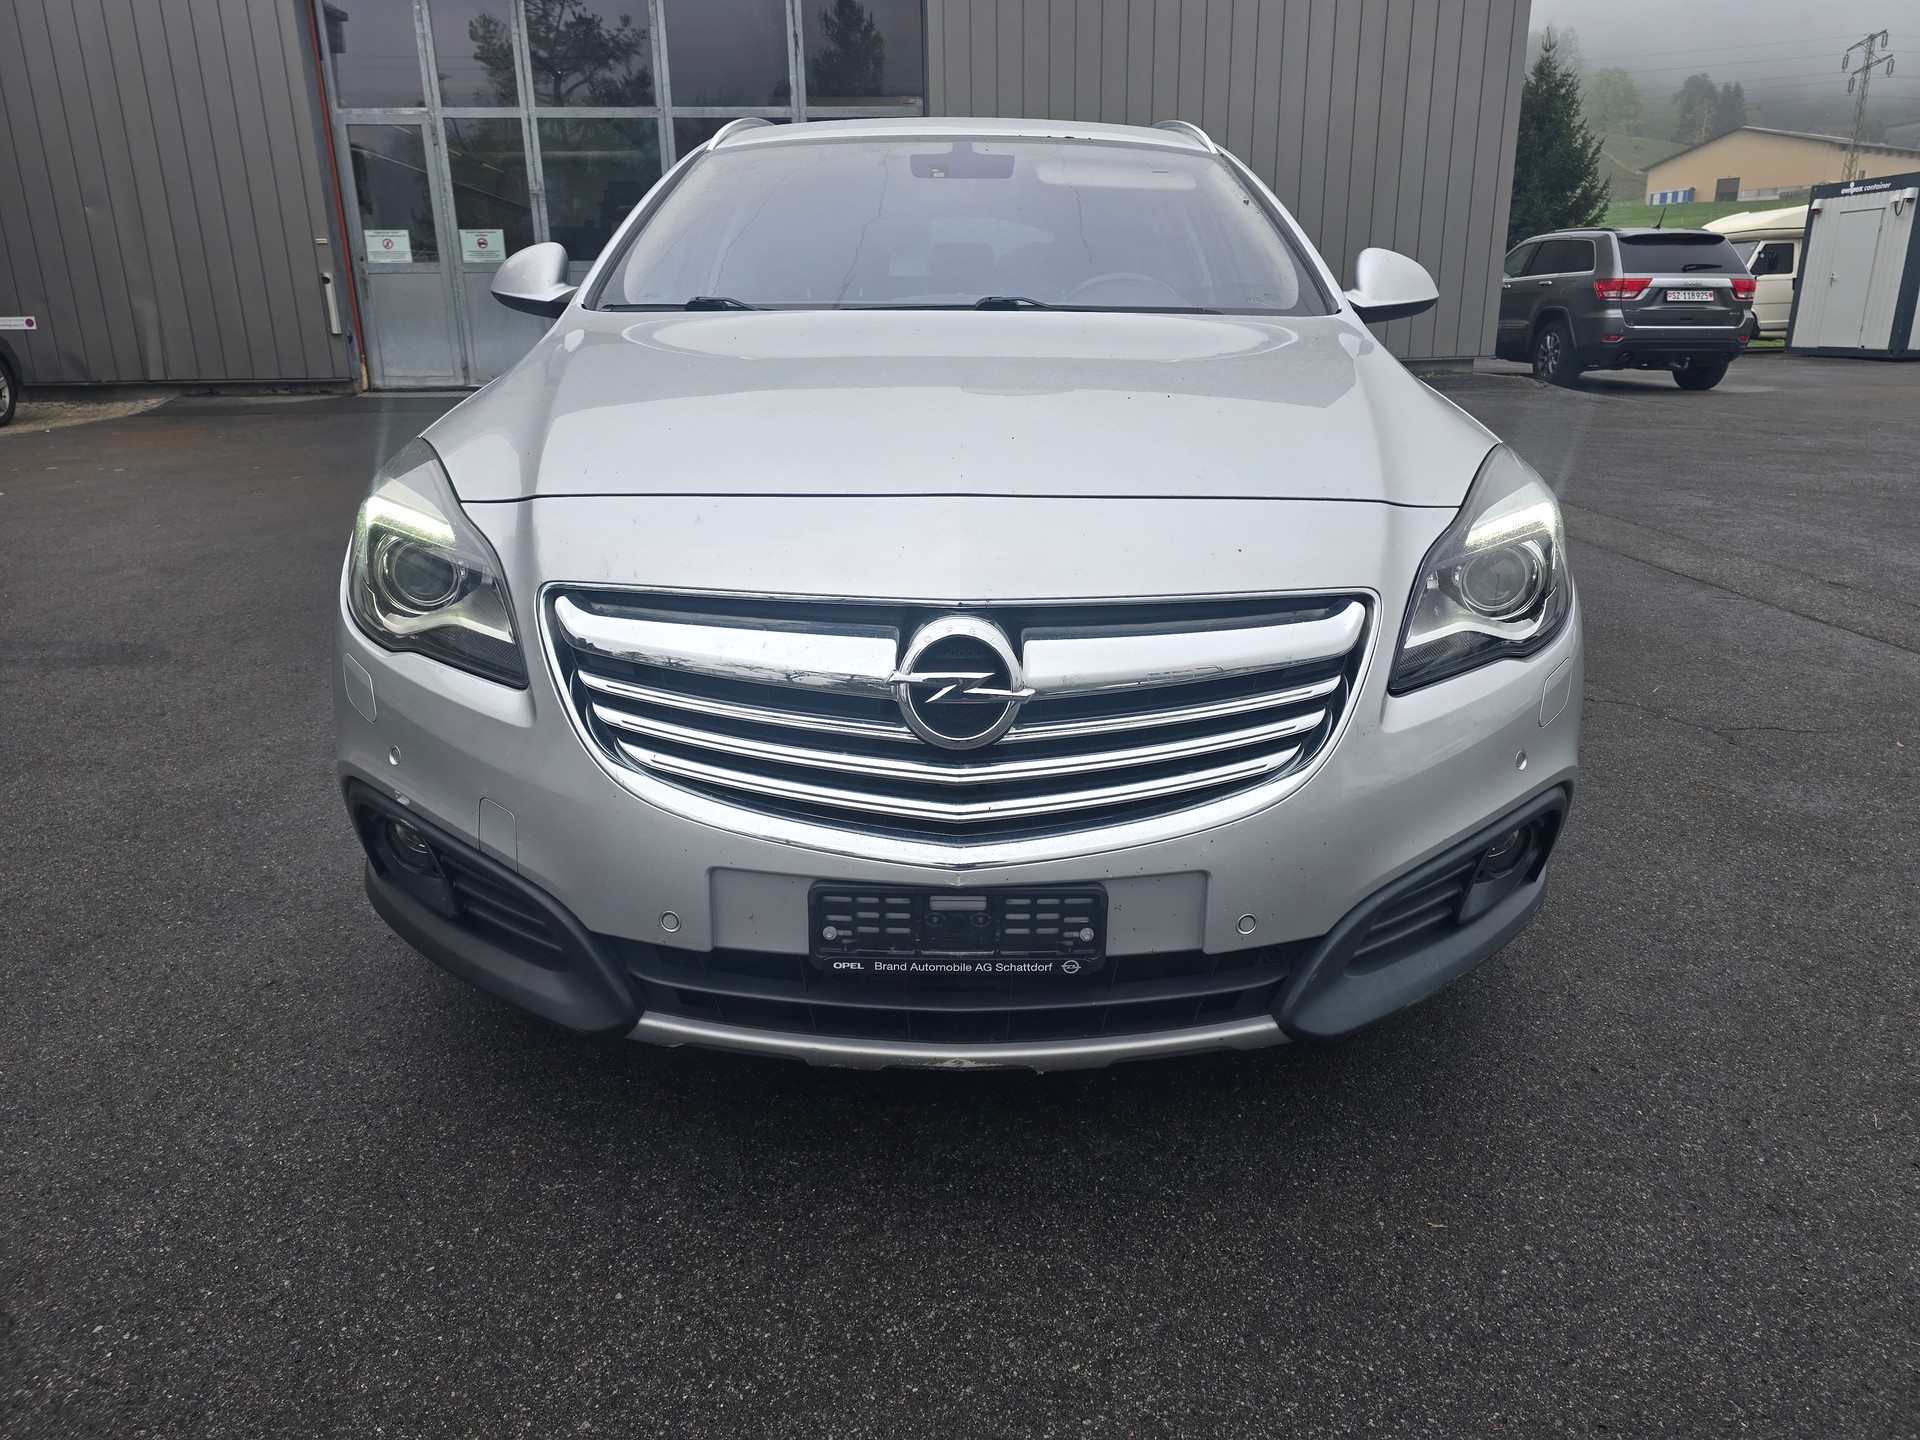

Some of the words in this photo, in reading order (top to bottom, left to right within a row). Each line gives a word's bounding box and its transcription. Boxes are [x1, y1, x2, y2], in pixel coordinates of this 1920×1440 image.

[1864, 182, 1892, 191] container
[923, 626, 997, 646] OPEL
[833, 962, 865, 970] OPEL
[874, 961, 908, 972] Brand
[909, 962, 973, 972] Automobile
[974, 962, 993, 972] AG
[995, 962, 1054, 972] Schattdorf
